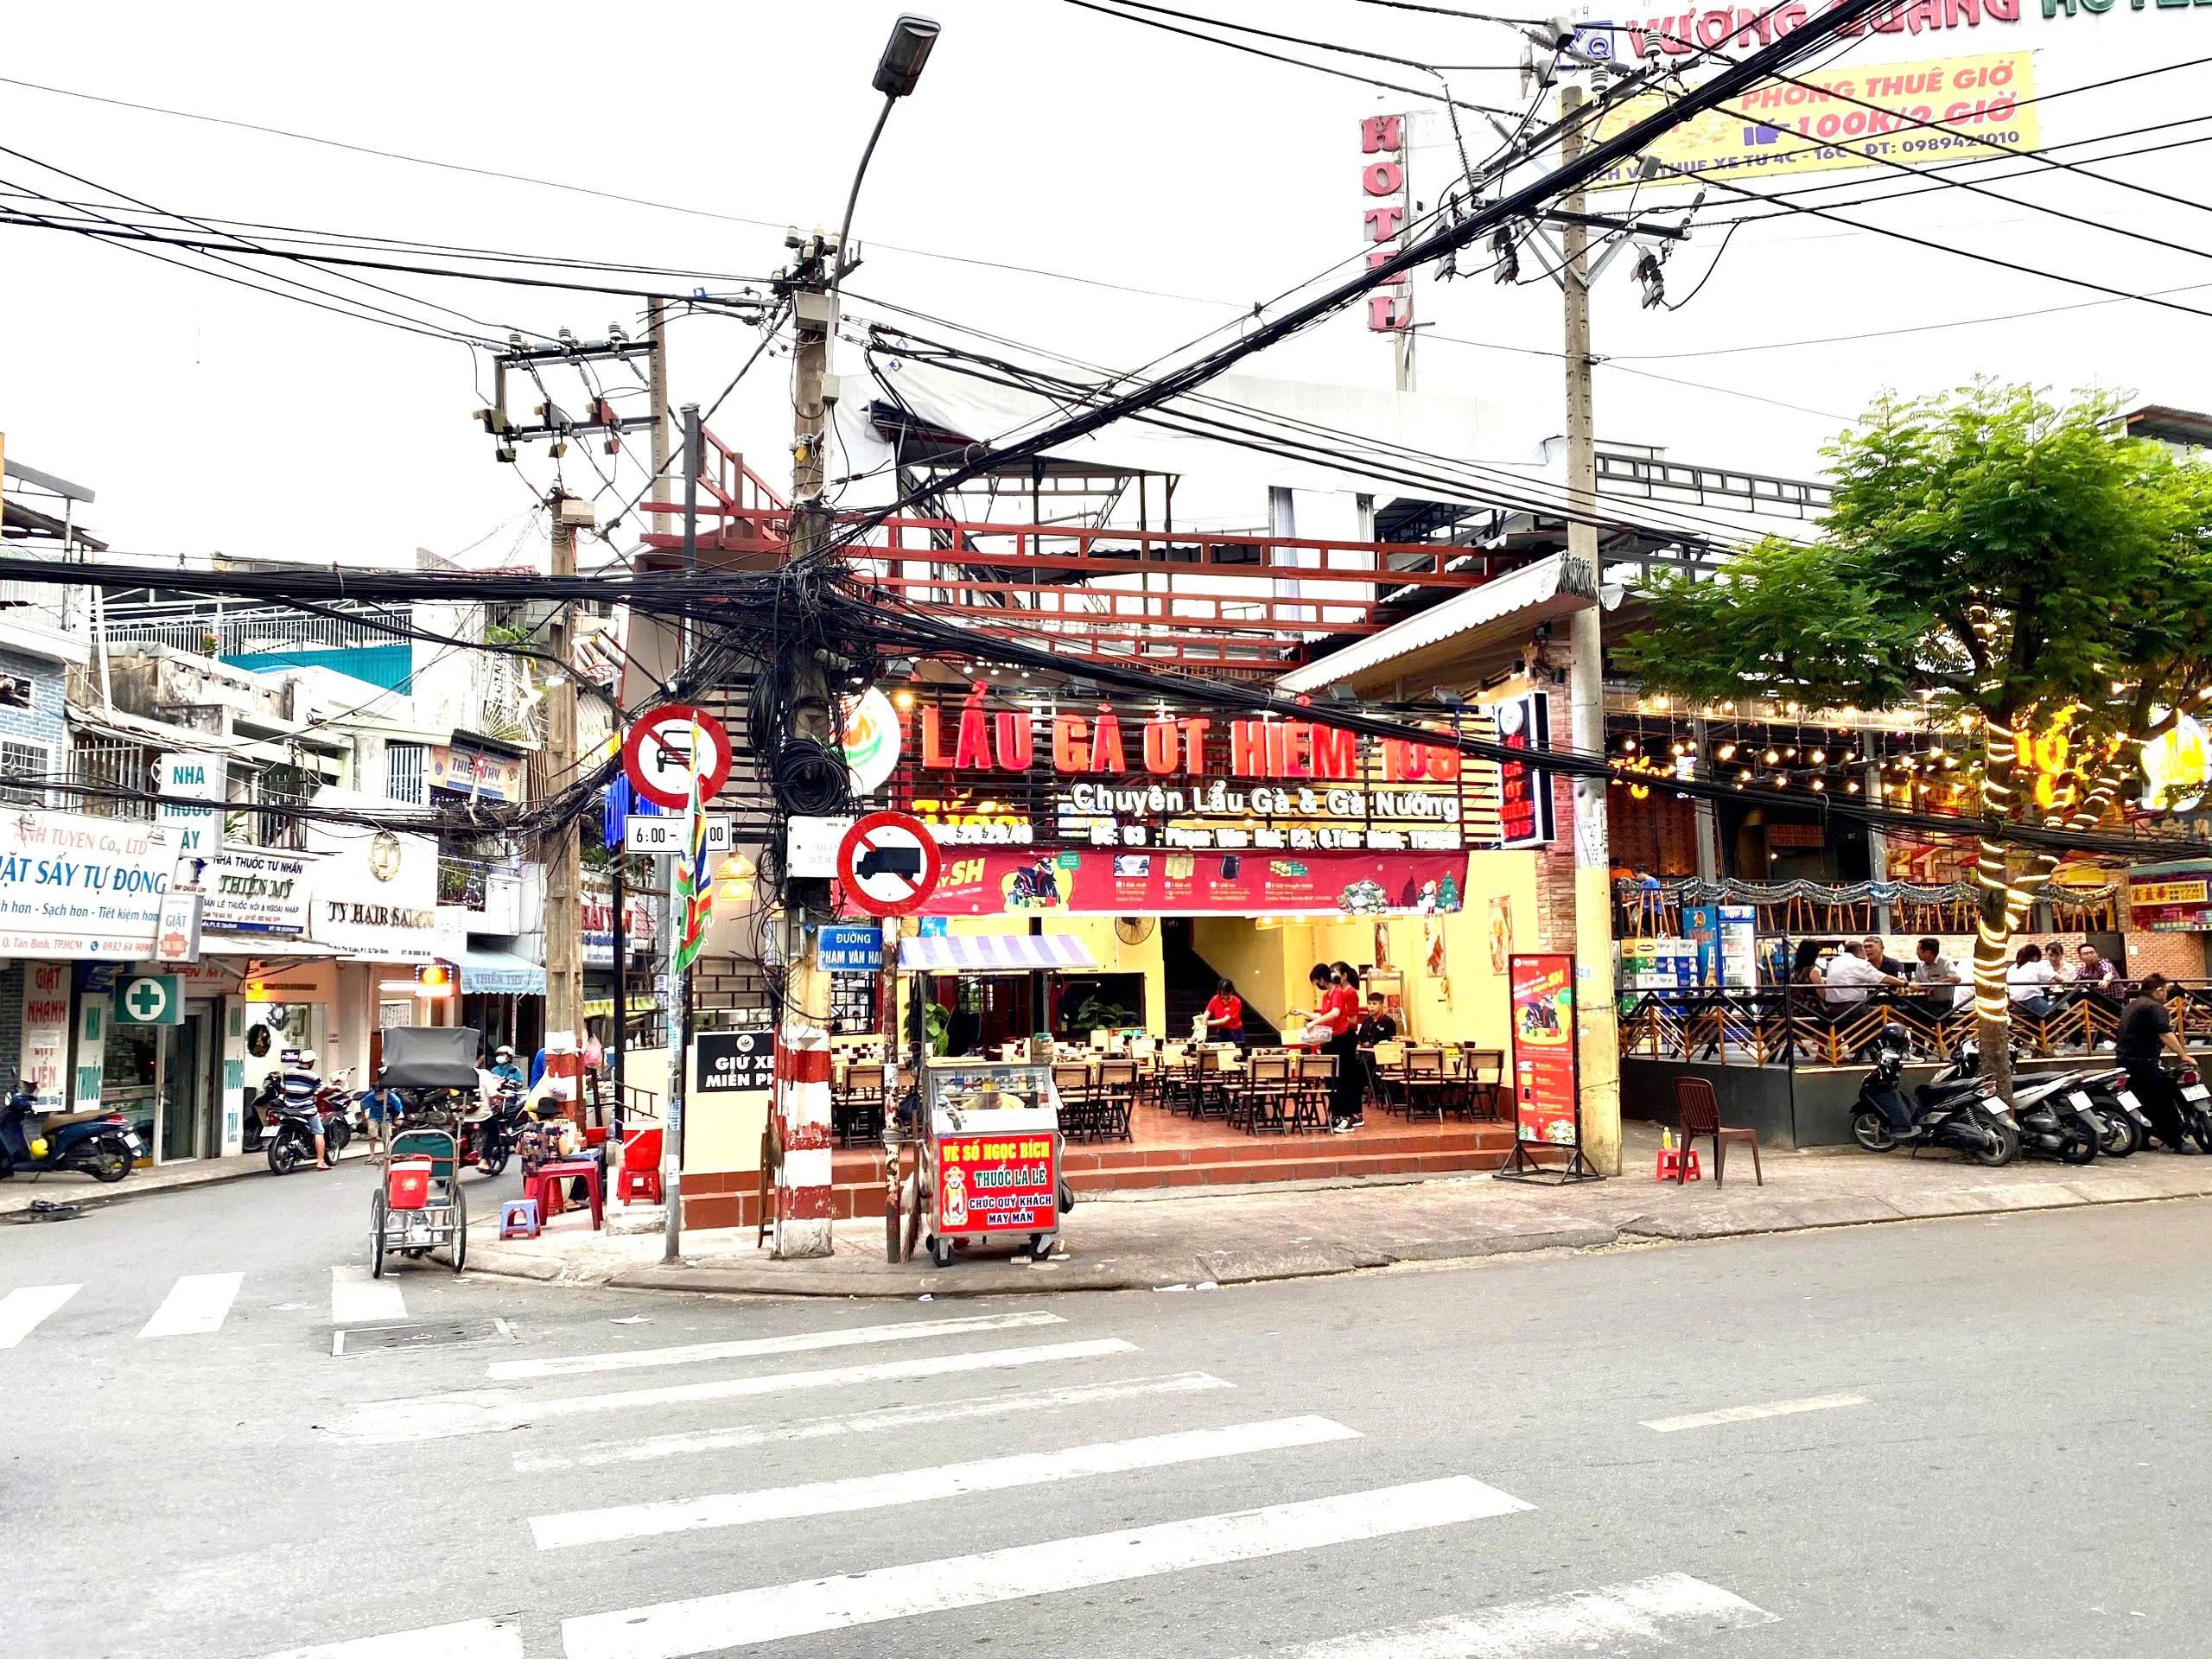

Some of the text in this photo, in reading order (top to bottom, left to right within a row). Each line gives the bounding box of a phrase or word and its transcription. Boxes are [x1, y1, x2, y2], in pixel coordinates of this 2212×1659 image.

[1830, 0, 2019, 37] UANG
[1866, 66, 1944, 98] THUÊ
[1953, 60, 2015, 90] GIỜ
[1944, 91, 2018, 126] GIỜ
[1052, 702, 1126, 774] GÀ
[1069, 782, 1185, 818] Chuyên
[1251, 786, 1291, 815] Gà
[1298, 788, 1319, 816] &
[1325, 788, 1367, 817] Gà
[1374, 790, 1460, 822] Nướng
[125, 837, 148, 855] LTD
[181, 826, 200, 849] ÂY
[636, 827, 665, 843] 6:00
[35, 851, 79, 887] SẤY
[84, 864, 111, 895] TỰ
[112, 862, 168, 898] ĐỘNG
[235, 855, 264, 870] THUỐC
[950, 857, 986, 887] SH
[11, 899, 32, 914] hơn
[41, 902, 67, 918] Sạch
[69, 905, 89, 918] hơn
[143, 909, 159, 922] hơn
[350, 902, 389, 926] HAIR
[836, 931, 871, 944] ĐƯỜNG
[753, 1055, 775, 1070] XE
[943, 1138, 1050, 1164] VÉ SỐ NGỌC BÍCH
[975, 1163, 1012, 1187] THUỐC
[969, 1192, 1053, 1209] CHÚC QUÝ KHÁCH
[988, 1212, 1010, 1224] MAY
